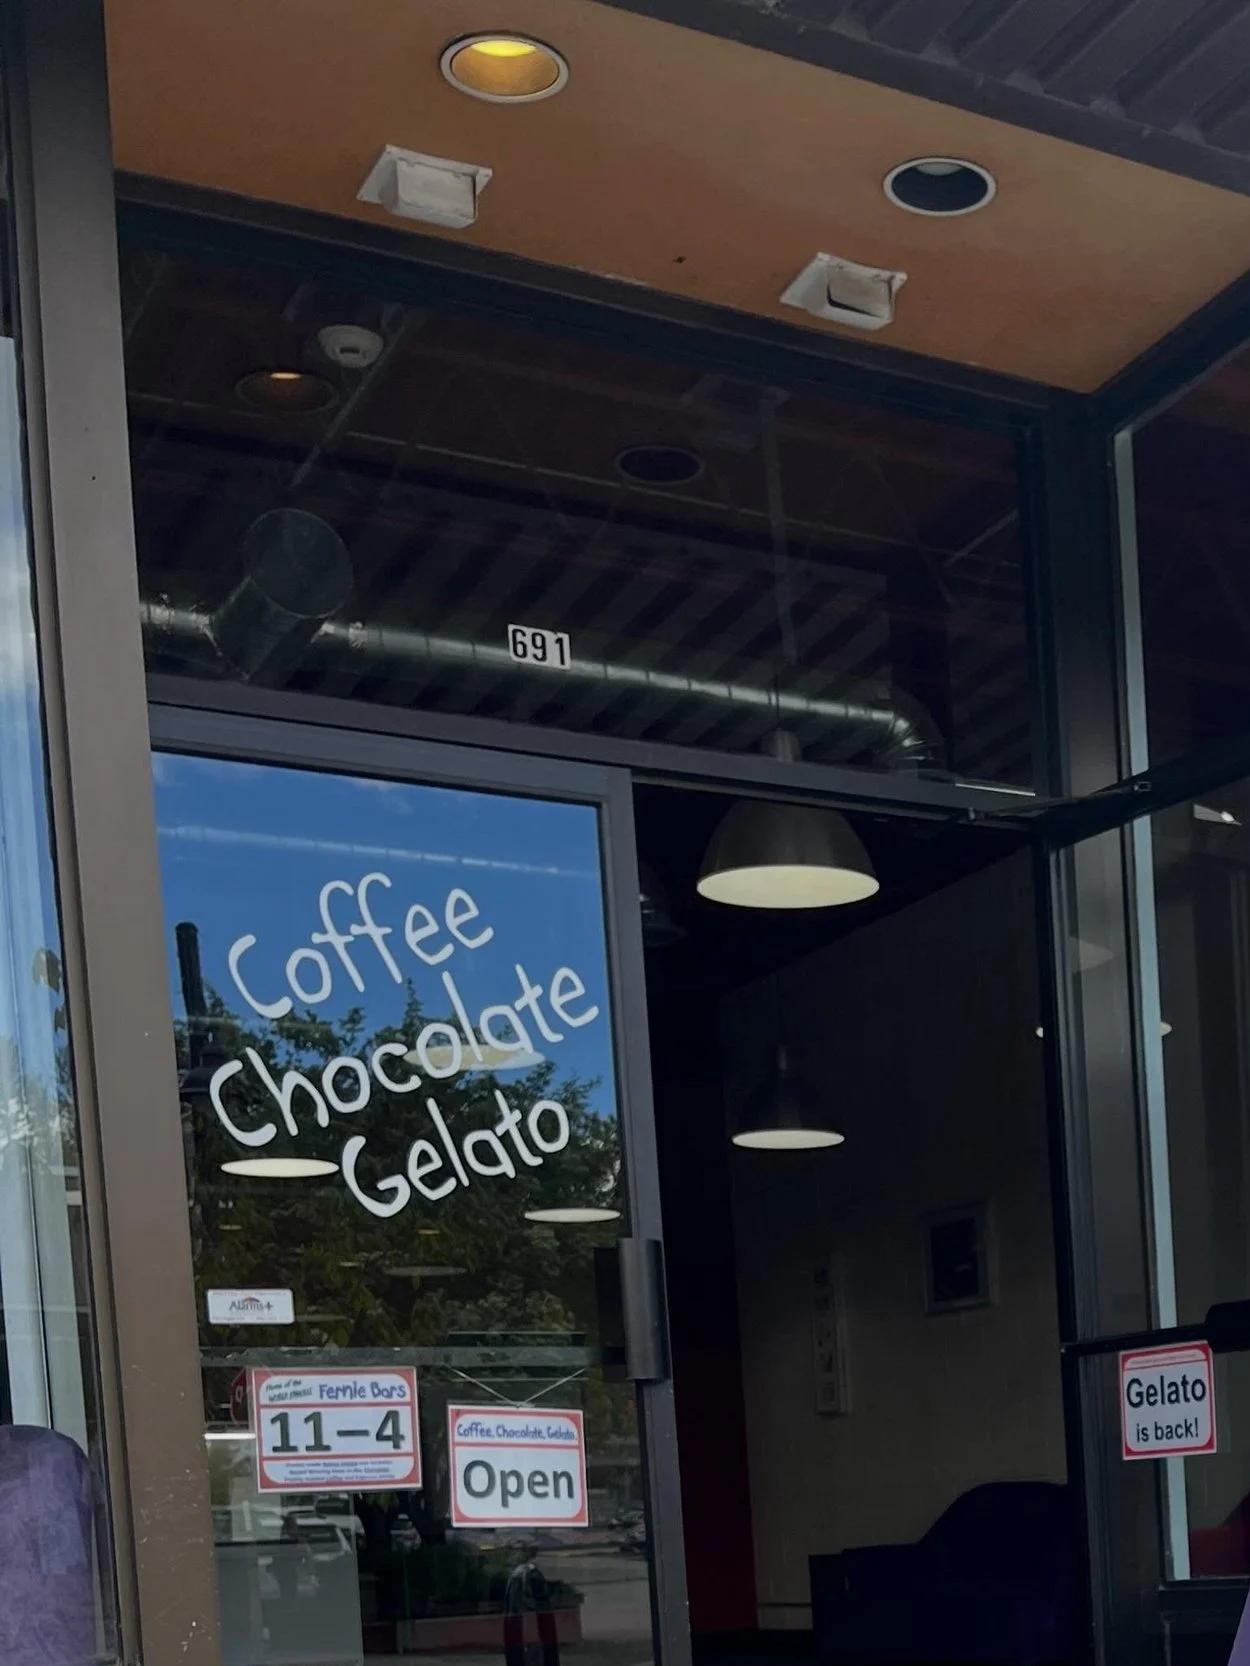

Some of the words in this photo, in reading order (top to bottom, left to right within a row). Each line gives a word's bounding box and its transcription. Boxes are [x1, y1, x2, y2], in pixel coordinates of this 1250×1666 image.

[511, 627, 568, 667] 691
[228, 873, 494, 1019] Coffee
[209, 964, 599, 1147] Chocolate
[342, 1089, 569, 1217] Gelato
[319, 1381, 367, 1400] Fernie
[370, 1381, 407, 1399] Bars
[1126, 1374, 1206, 1408] Gelato
[1136, 1423, 1149, 1442] is
[1154, 1417, 1199, 1441] back!
[463, 1460, 574, 1508] Open
